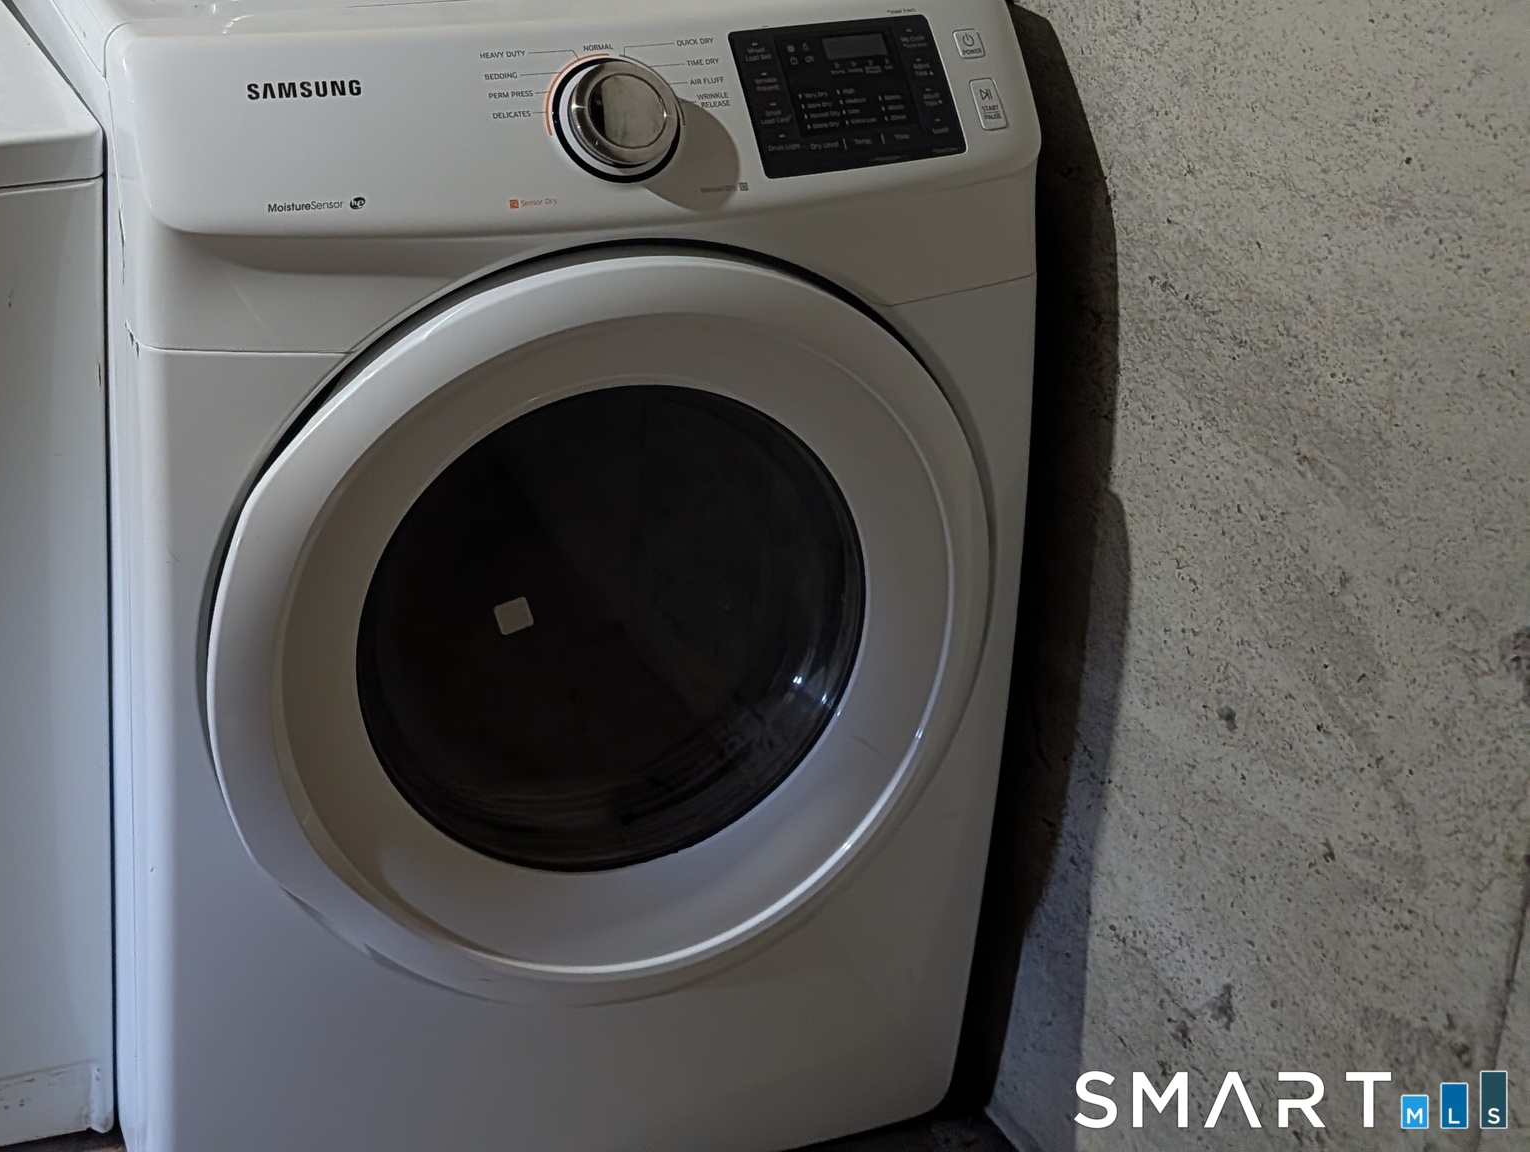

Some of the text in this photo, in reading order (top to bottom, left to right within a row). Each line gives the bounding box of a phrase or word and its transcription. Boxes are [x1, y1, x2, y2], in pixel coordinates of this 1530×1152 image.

[676, 37, 714, 46] QUICK DRY
[583, 43, 614, 52] NORMAL
[480, 51, 504, 59] HEAVY
[686, 57, 720, 67] TIME DRY
[484, 72, 518, 80] BEDDING
[703, 76, 724, 84] FLUFF
[247, 79, 362, 100] SAMSUNG
[488, 89, 533, 99] PERM PRESS
[697, 92, 729, 100] WRINKLE
[701, 100, 731, 108] RELEASE
[492, 110, 531, 119] DELICATES
[267, 199, 344, 213] MoistureSensor
[521, 198, 557, 207] Sensor Dry
